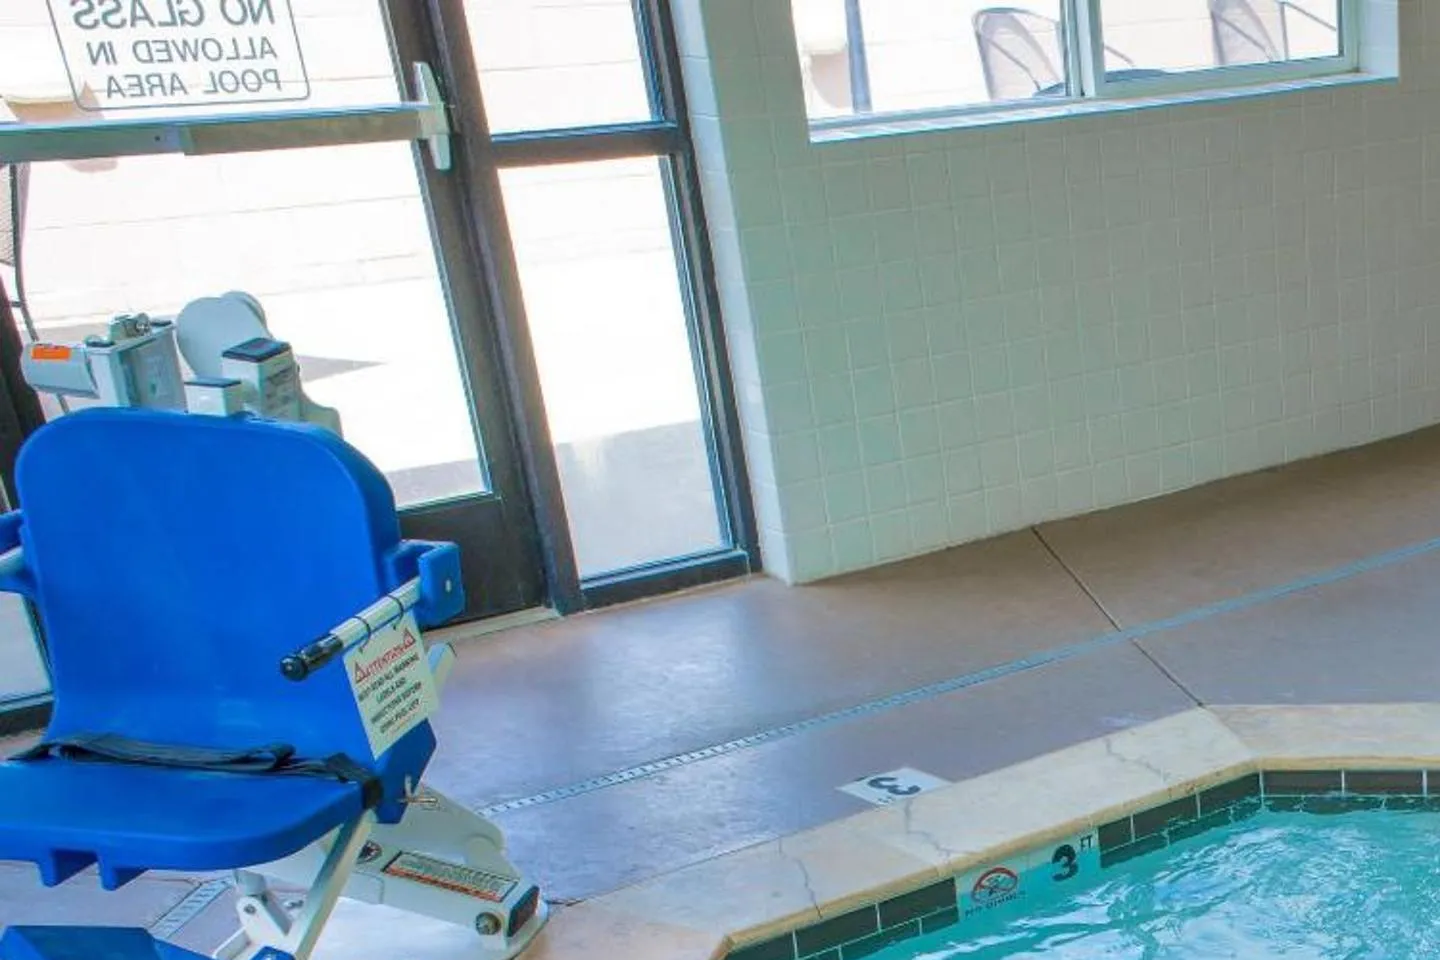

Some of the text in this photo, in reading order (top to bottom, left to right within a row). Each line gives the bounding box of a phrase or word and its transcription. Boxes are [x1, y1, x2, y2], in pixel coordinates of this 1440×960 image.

[867, 777, 921, 795] 3
[1052, 834, 1093, 882] 3 FT
